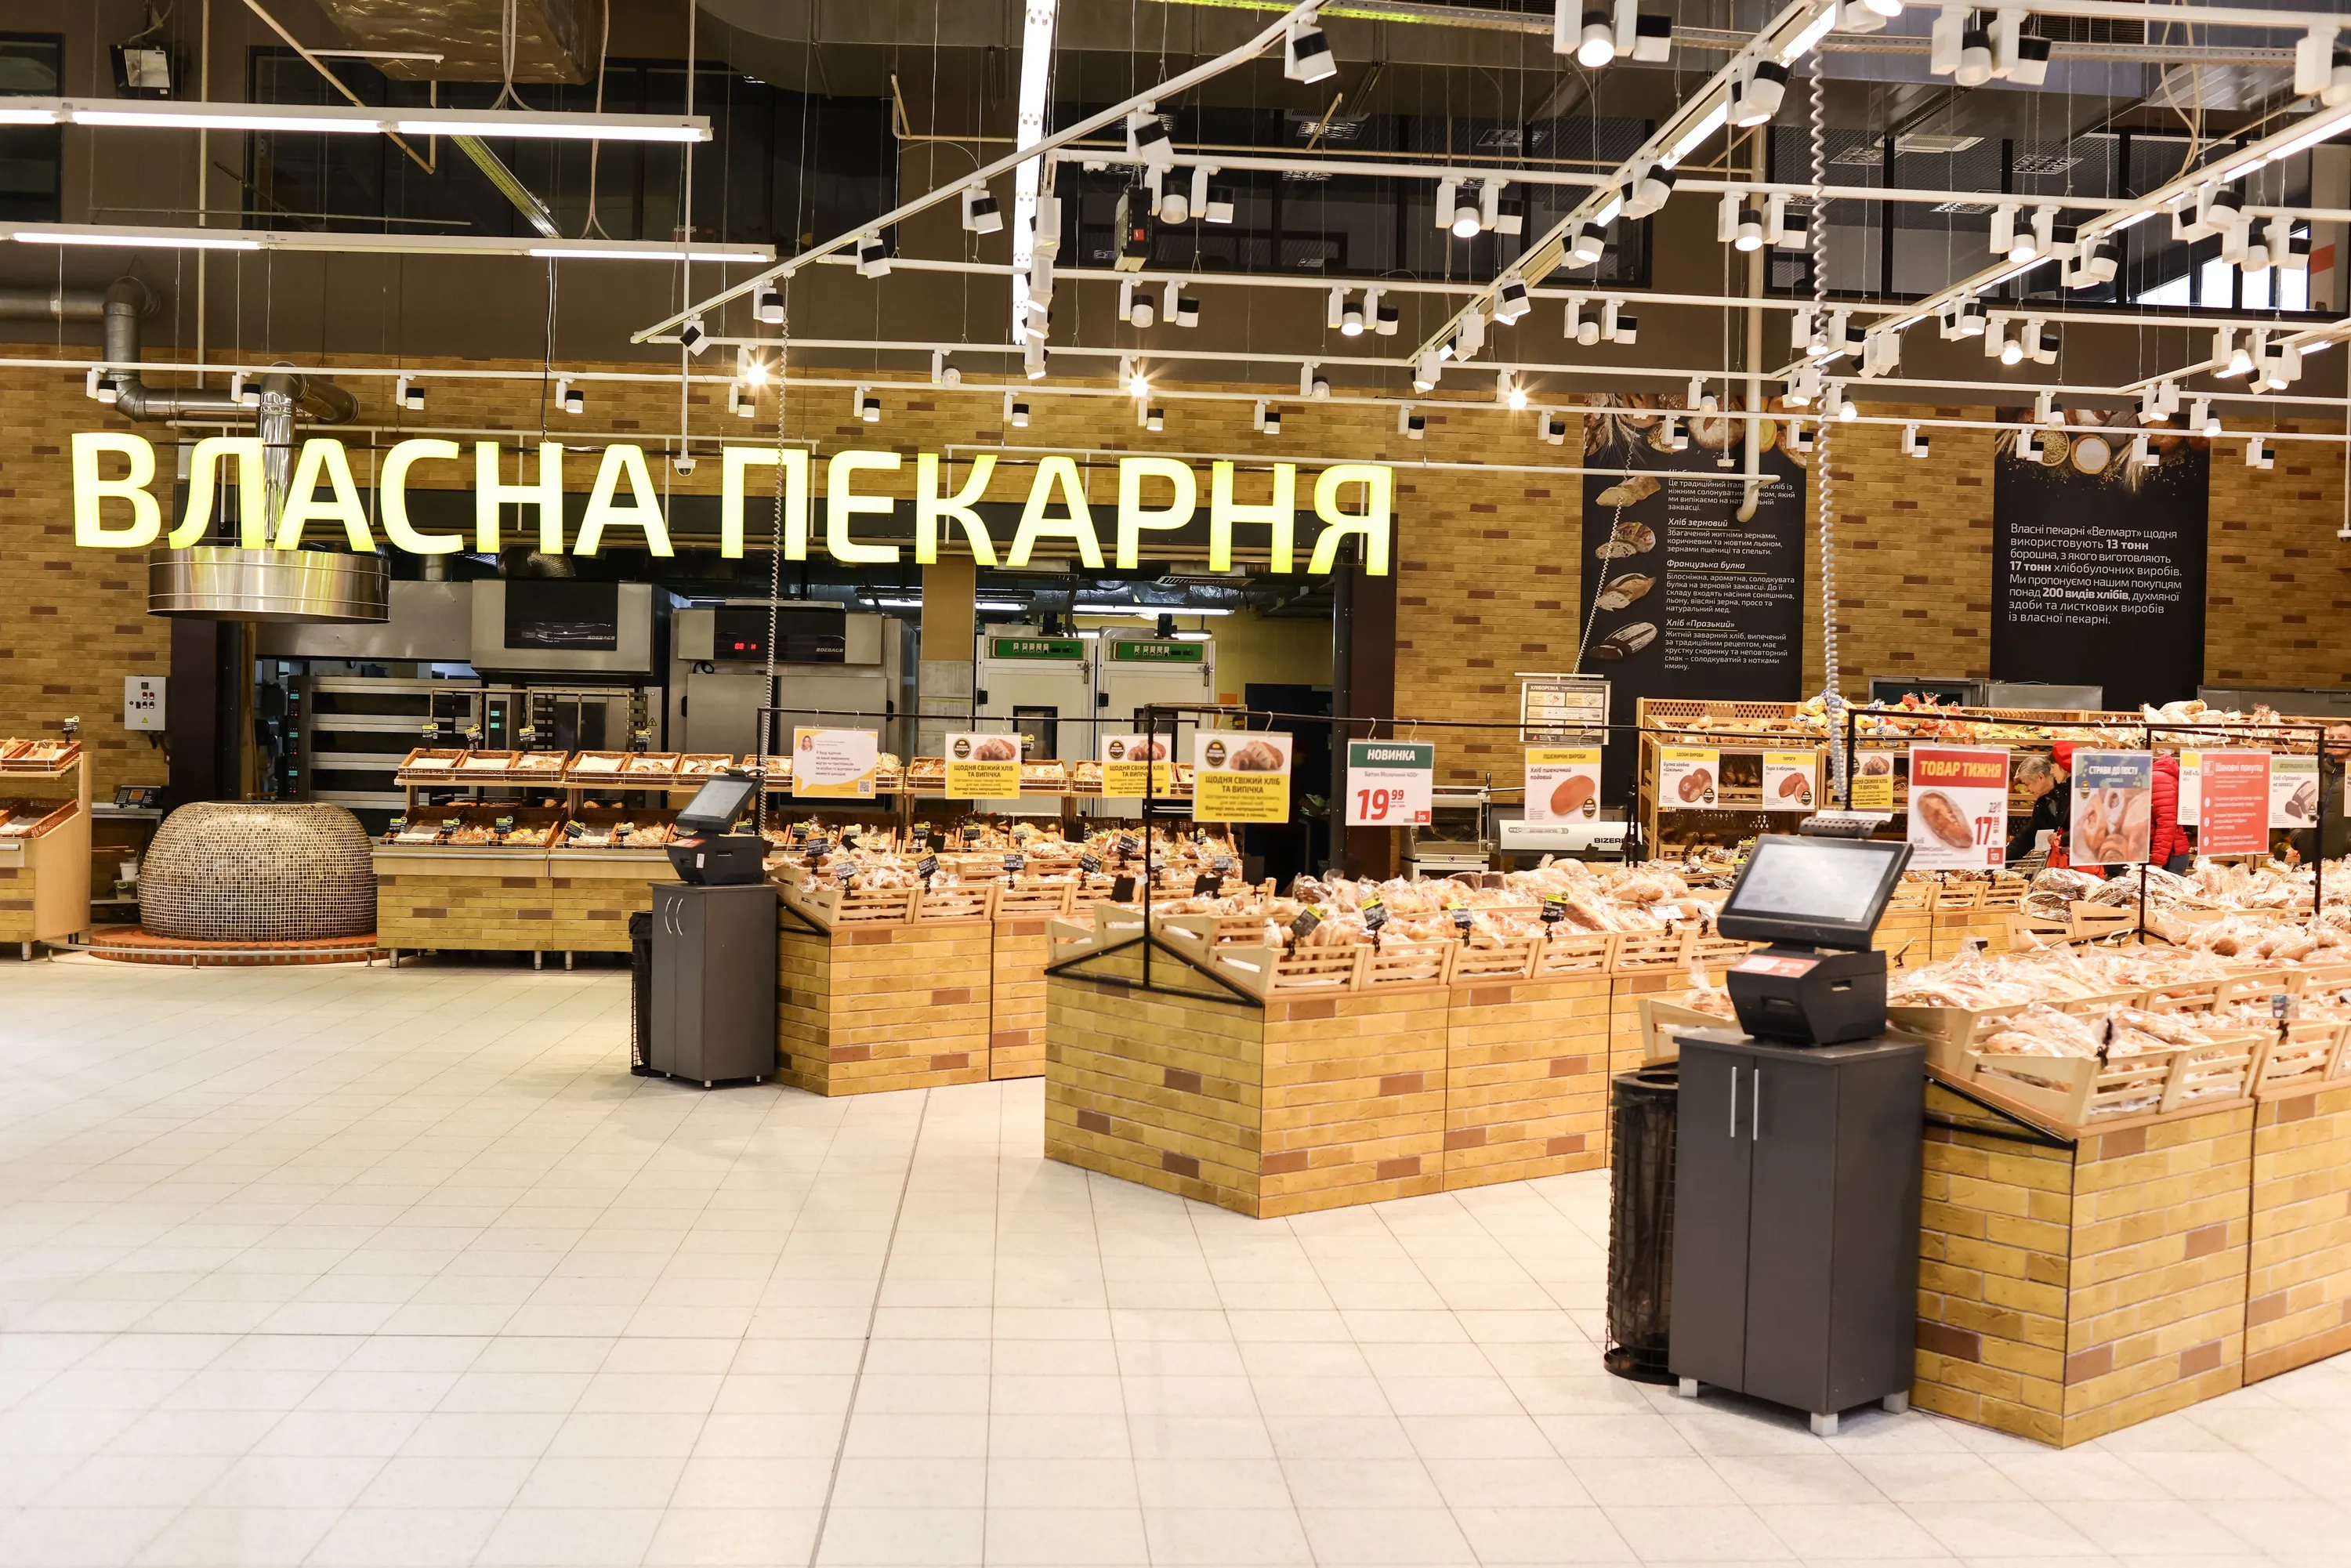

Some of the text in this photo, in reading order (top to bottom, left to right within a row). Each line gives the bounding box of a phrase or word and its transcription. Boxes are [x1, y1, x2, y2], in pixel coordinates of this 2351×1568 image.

[71, 432, 1394, 576] ВЛАСНА ПЕКАРНЯ
[1688, 520, 1728, 528] зерновий
[2011, 523, 2177, 540] Власні пекарні «Велмарт» щодня
[2010, 538, 2103, 550] використовують
[2106, 539, 2118, 549] 13
[2010, 549, 2059, 561] борошна,
[2068, 552, 2097, 561] якого
[2099, 553, 2171, 563] виготовляють
[1667, 559, 1745, 570] Французька булка
[2009, 561, 2183, 578] 17 тонн хлібобулочних виробів.
[1700, 581, 1731, 590] зерновій
[2009, 574, 2182, 590] Ми пропонуємо нашим покупцям
[2009, 588, 2179, 603] понад 200 видів хлібів, духмяної
[2009, 601, 2164, 615] здоби та листкових виробів
[1666, 618, 1735, 628] Хліб «Празький»
[2009, 612, 2110, 625] із власної пекарні.
[1675, 639, 1722, 648] традиційним
[1367, 749, 1415, 761] НОВИНКА
[1920, 761, 2001, 777] ТОВАР ТИЖНЯ
[2088, 766, 2111, 775] СТРАВИ
[2215, 762, 2240, 772] Шановні
[1357, 789, 1404, 820] 19 99
[1976, 817, 1993, 845] 17
